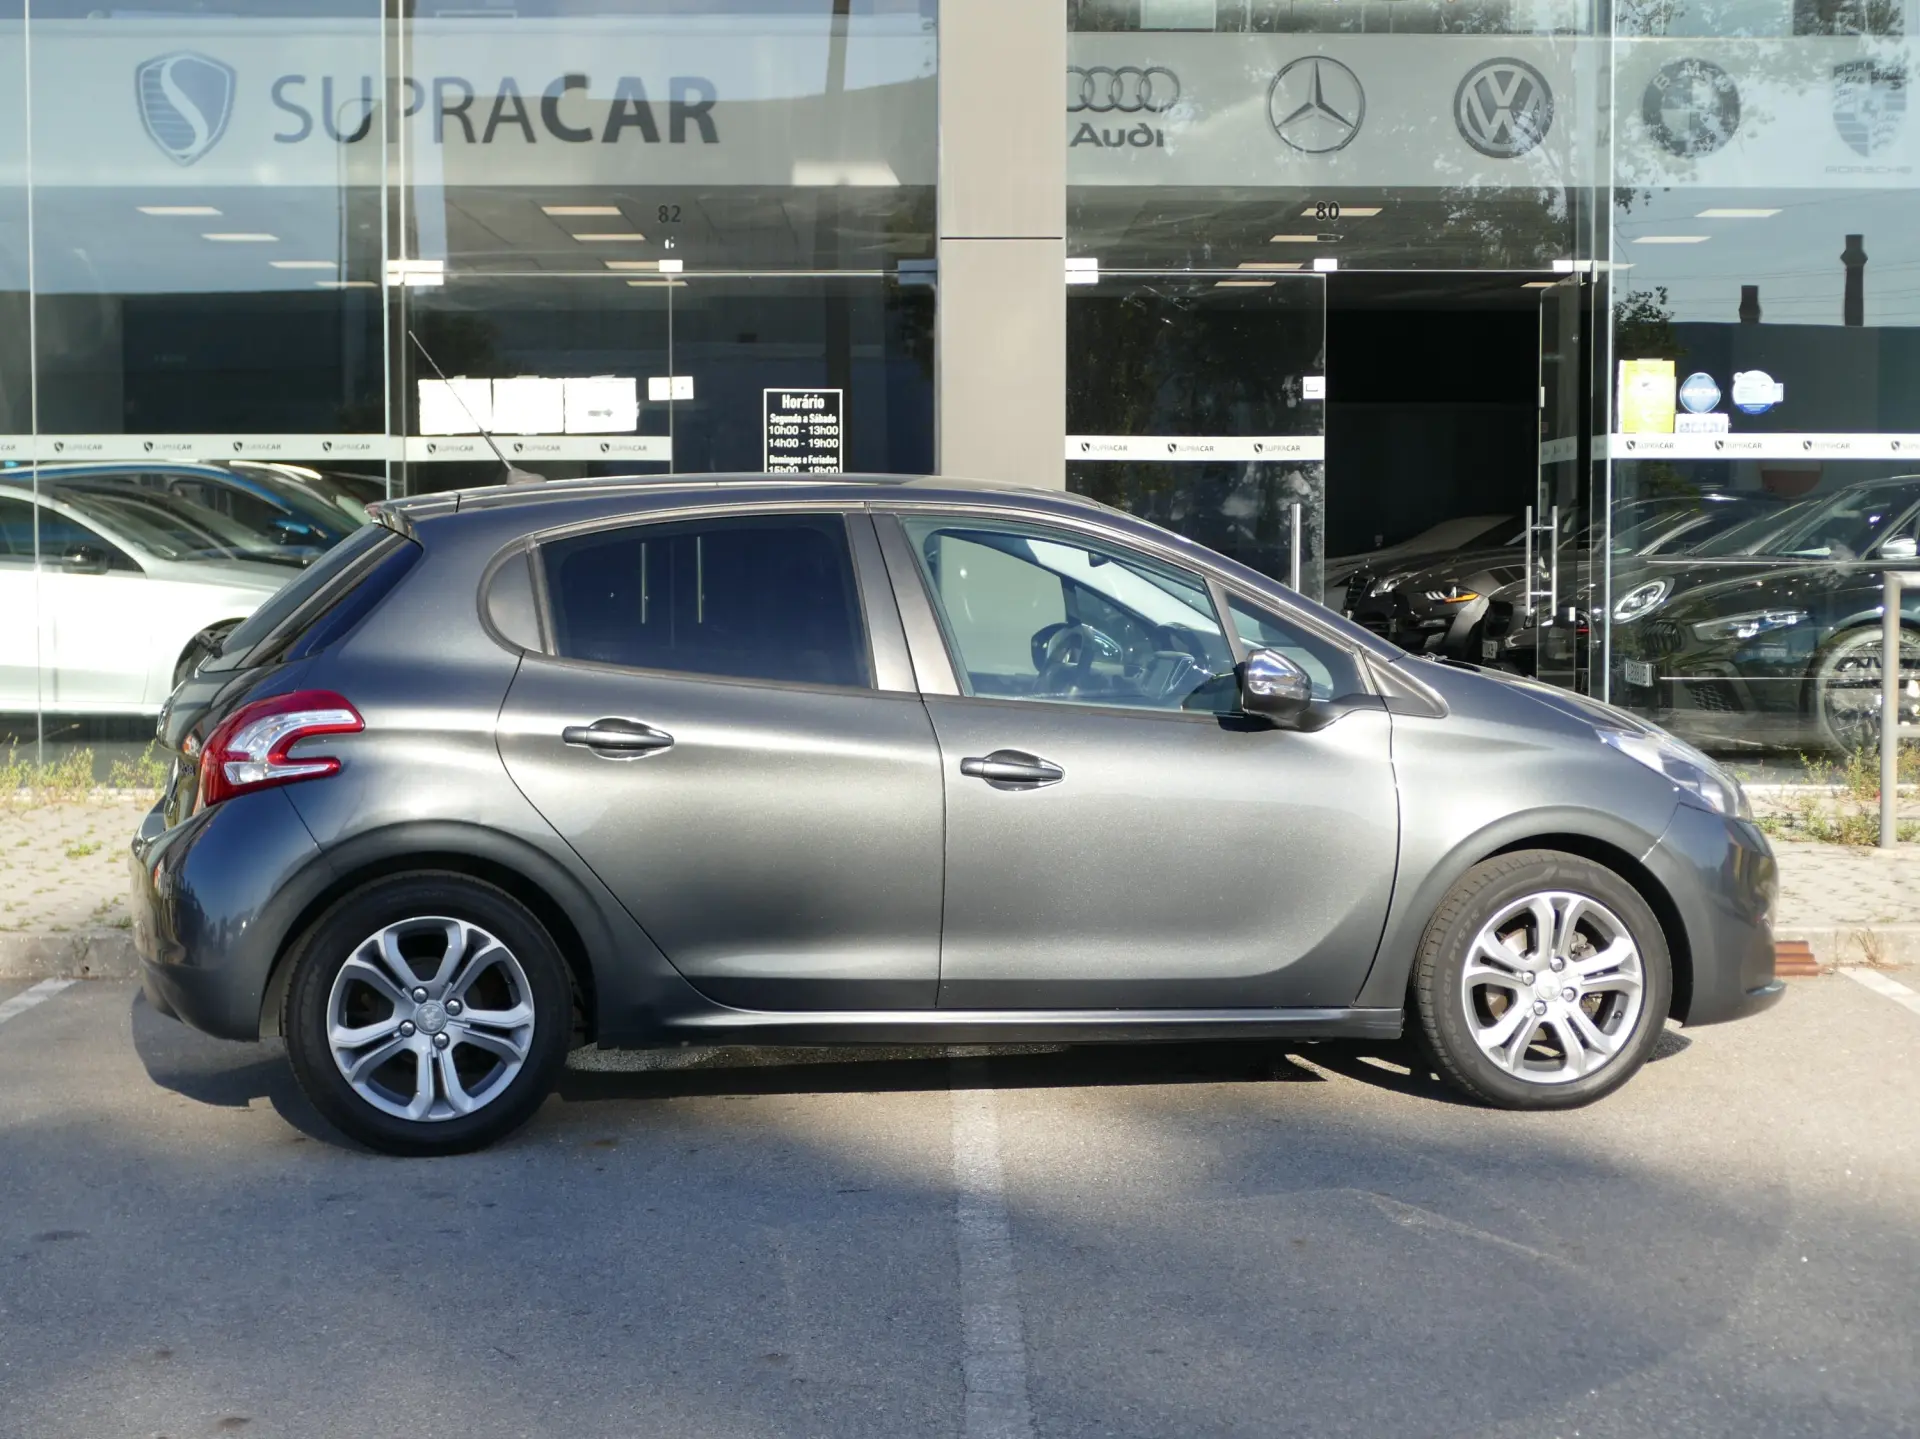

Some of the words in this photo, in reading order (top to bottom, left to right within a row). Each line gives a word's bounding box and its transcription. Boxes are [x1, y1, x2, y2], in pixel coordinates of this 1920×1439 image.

[271, 73, 720, 144] SUPRACAR
[1069, 122, 1164, 148] Audi
[658, 205, 682, 224] 82
[1315, 201, 1340, 220] 80
[781, 393, 825, 409] Horário
[770, 413, 802, 425] Segunda
[809, 413, 837, 424] Sábado
[768, 425, 800, 435] 10h00
[808, 425, 839, 435] 13h00
[768, 438, 800, 448] 14h00
[808, 438, 839, 448] 19h00
[808, 455, 837, 464] Feriados
